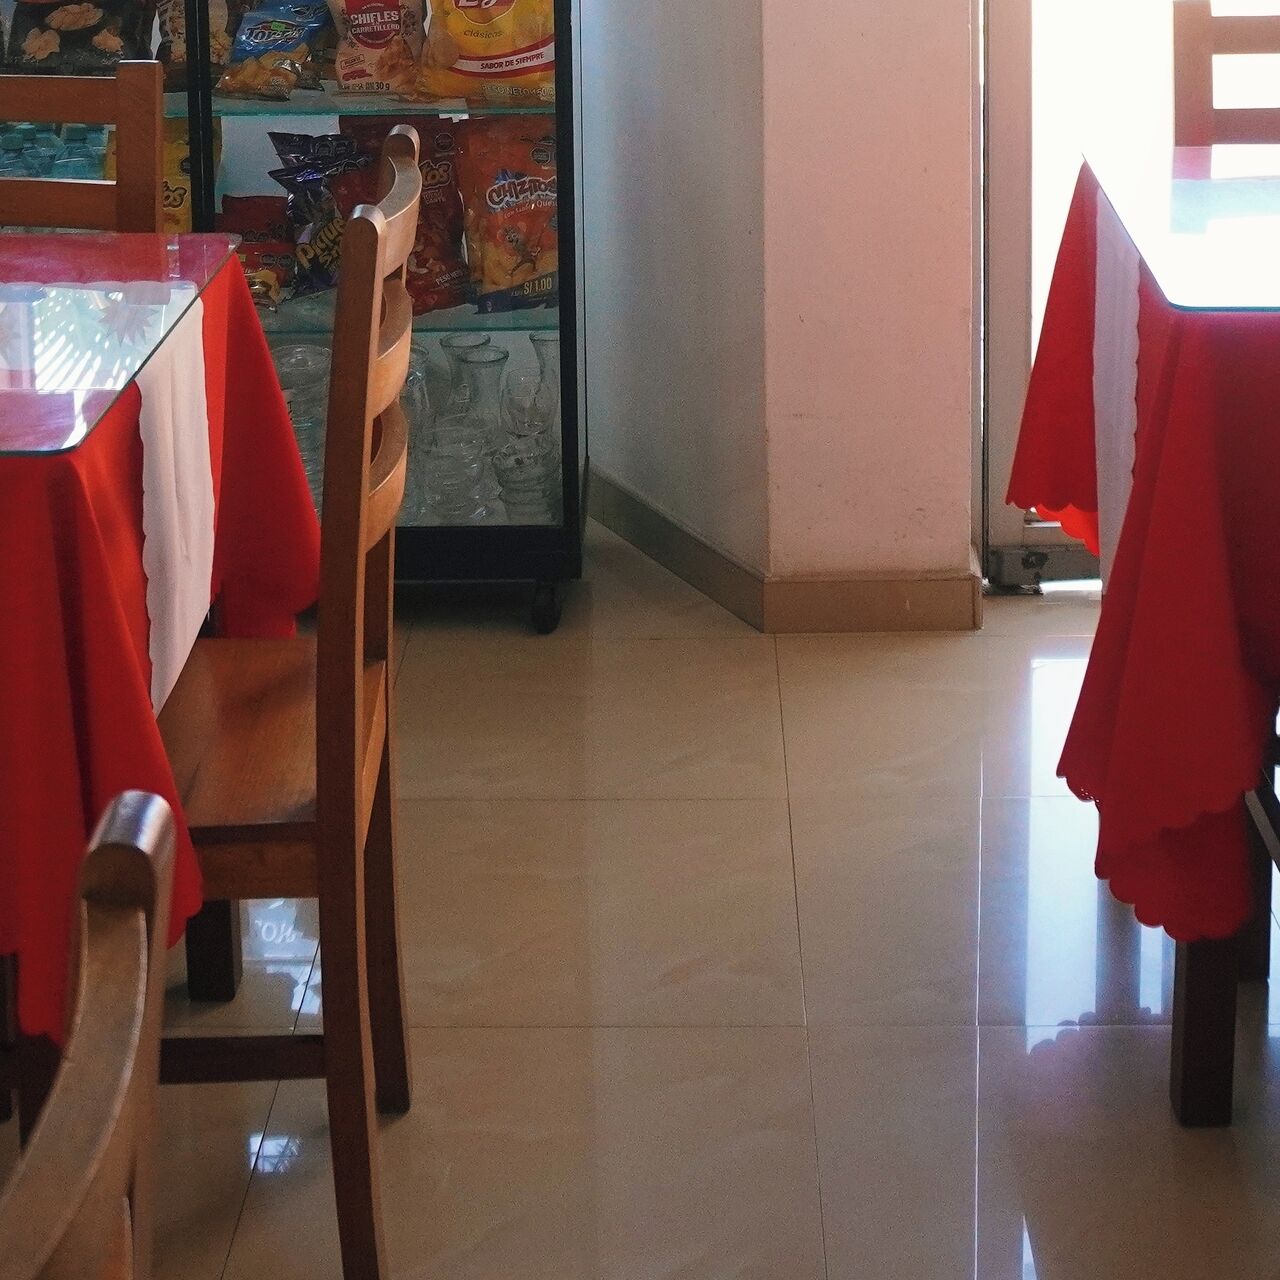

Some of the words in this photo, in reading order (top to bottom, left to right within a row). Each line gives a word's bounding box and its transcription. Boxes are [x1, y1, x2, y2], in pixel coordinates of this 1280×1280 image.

[350, 10, 400, 26] CHIFLES
[480, 61, 504, 70] SABOR
[505, 59, 515, 67] DE
[515, 51, 545, 66] SIEMPRE
[375, 82, 383, 90] 30
[385, 83, 390, 91] g
[535, 277, 552, 293] 1.00
